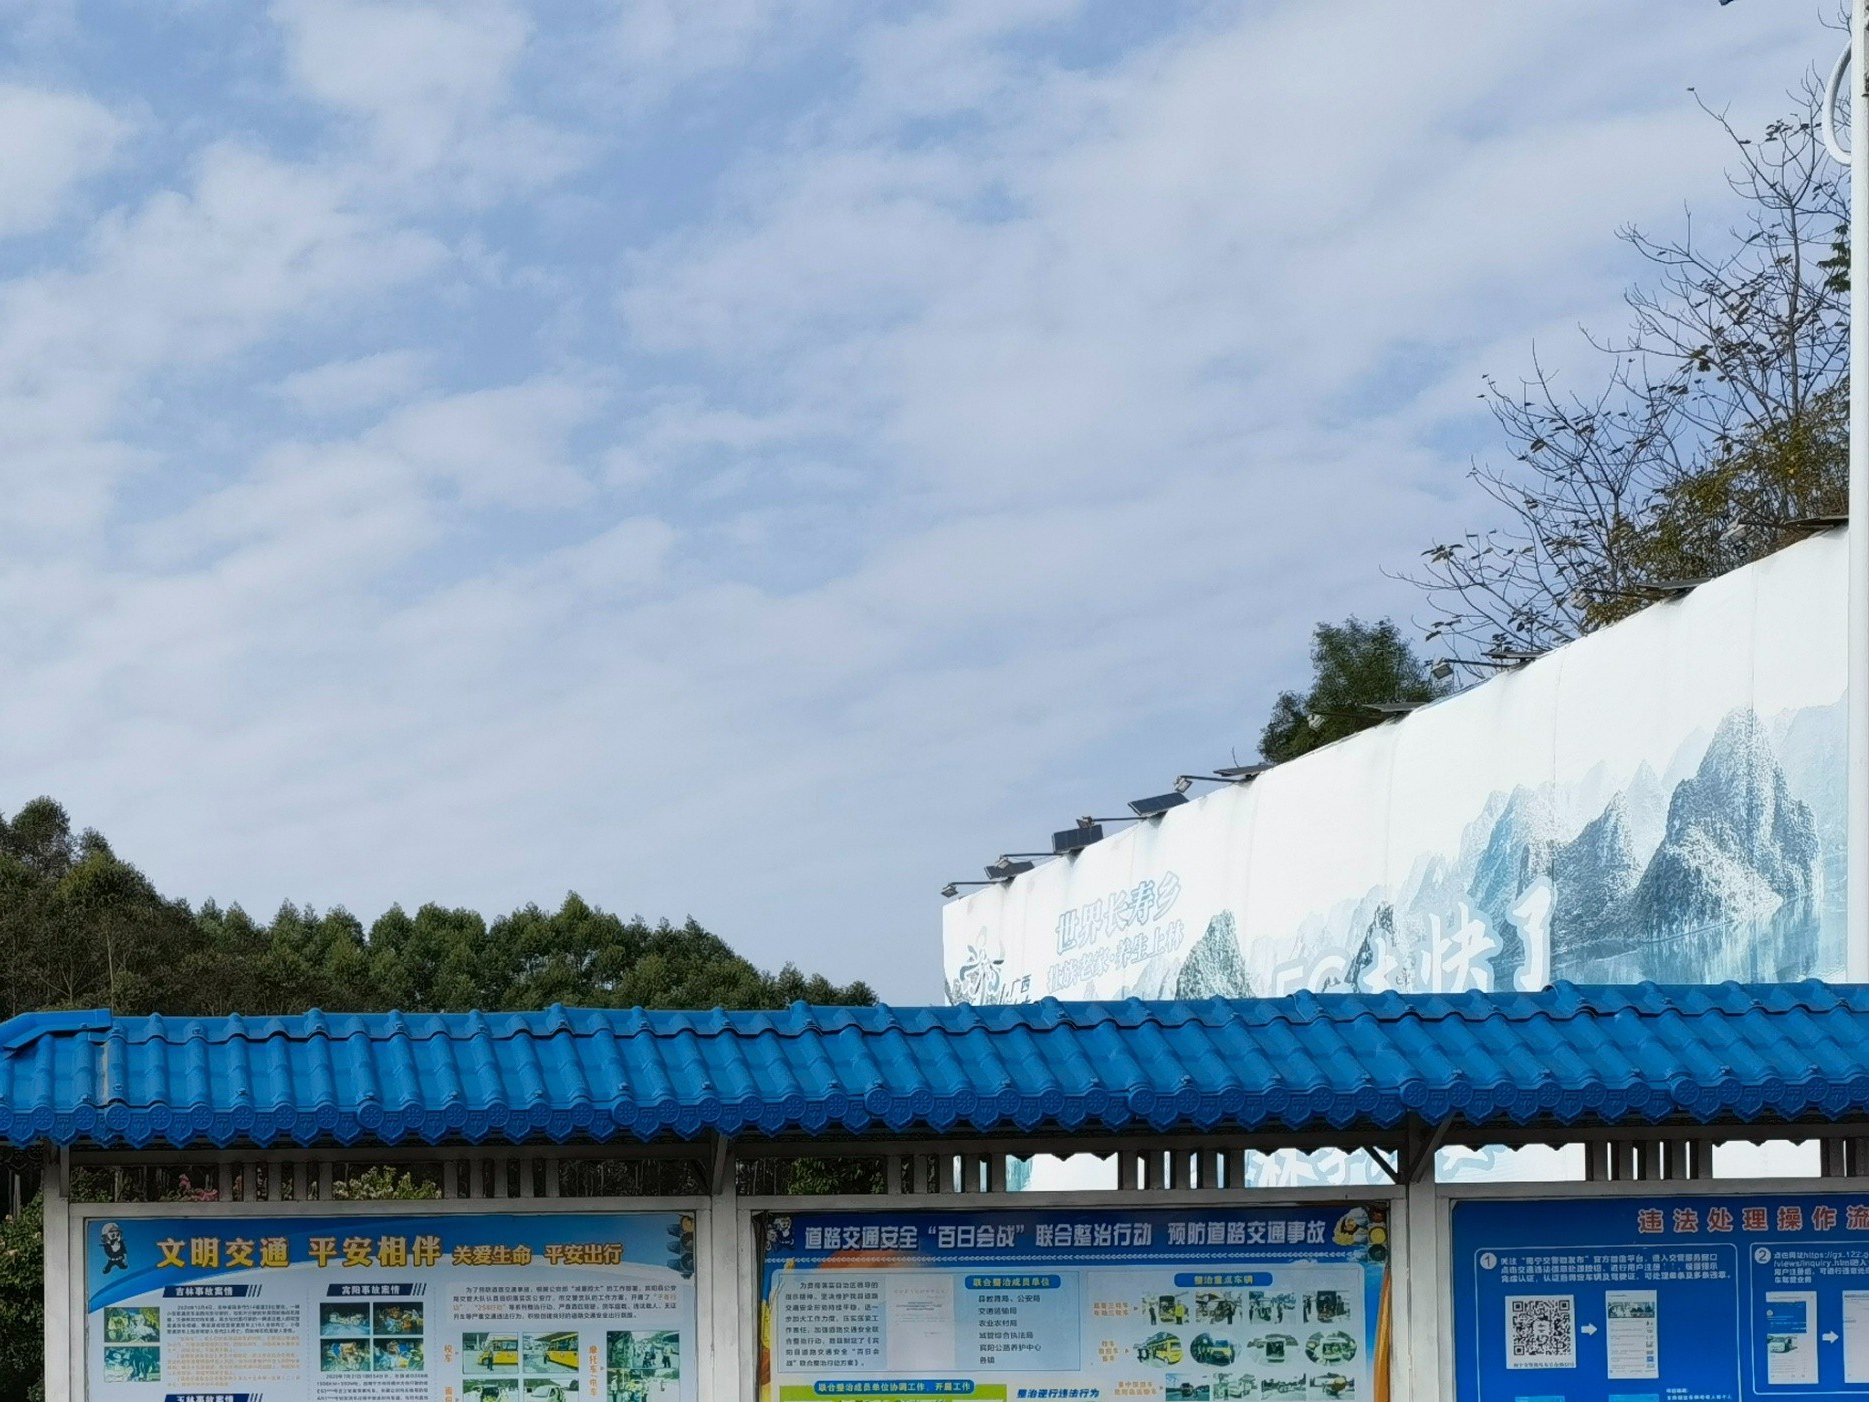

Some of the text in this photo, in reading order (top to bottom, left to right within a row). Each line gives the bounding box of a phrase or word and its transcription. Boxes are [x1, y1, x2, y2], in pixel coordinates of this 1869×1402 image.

[1055, 869, 1181, 957] 世界长寿乡
[1167, 1220, 1326, 1246] 预防道路交通事故
[155, 1234, 623, 1268] 文明交通 平安相伴 关爱生命 平安出行
[175, 1286, 233, 1296] 吉林事故案情
[341, 1285, 400, 1295] 宾阳事故案情
[978, 1319, 1017, 1327] 农业农村局
[1016, 1388, 1100, 1399] 整治逆行违法行为
